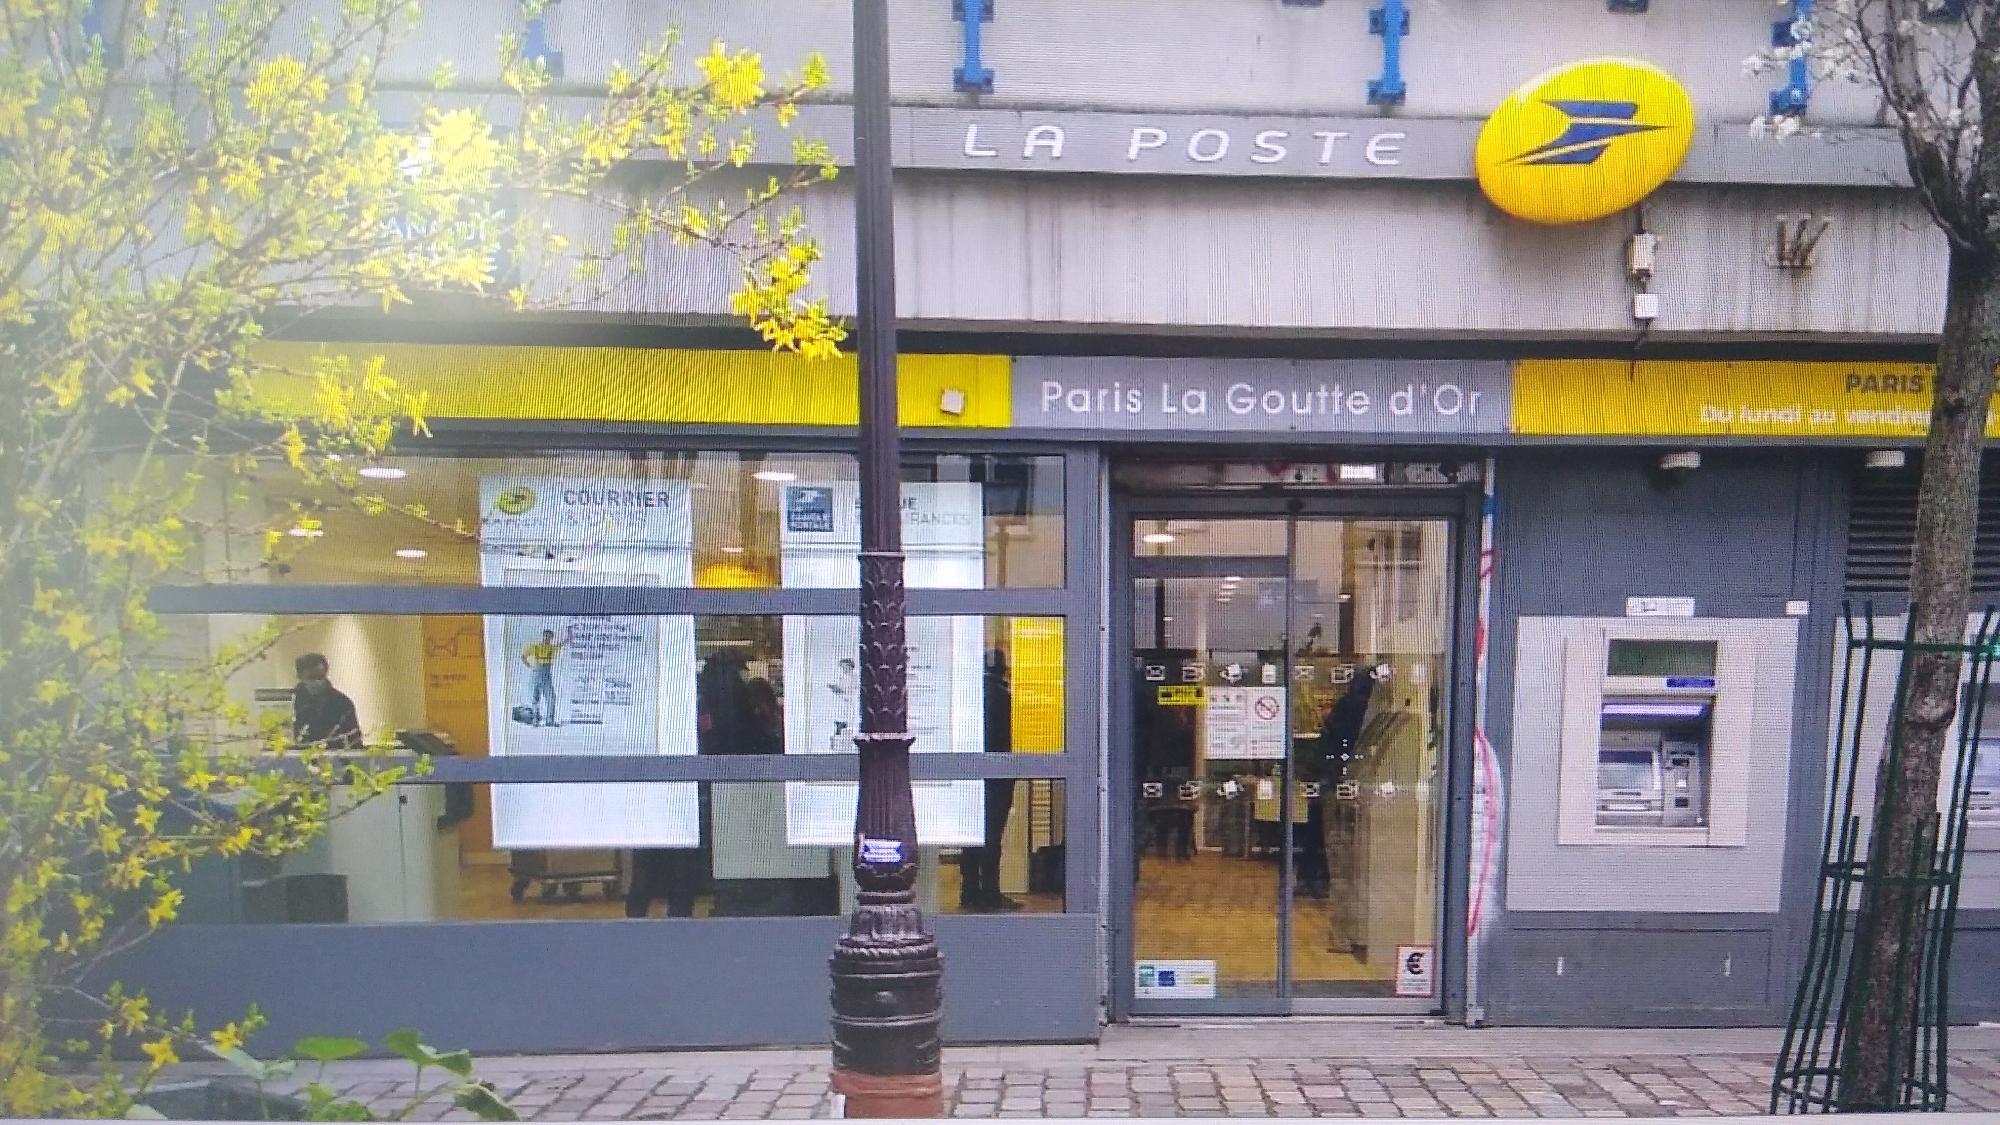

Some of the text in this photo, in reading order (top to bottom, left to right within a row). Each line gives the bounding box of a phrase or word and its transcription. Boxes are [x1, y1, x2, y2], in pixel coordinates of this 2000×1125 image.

[963, 123, 1406, 168] LA POSTE
[1845, 373, 1925, 394] PARIS
[1041, 380, 1482, 416] Paris La Goutte d'Or
[1739, 402, 1801, 424] lundi
[1809, 407, 1837, 425] au
[1844, 404, 1931, 426] vendre
[563, 488, 671, 508] COURRIER
[1405, 951, 1425, 975] €
